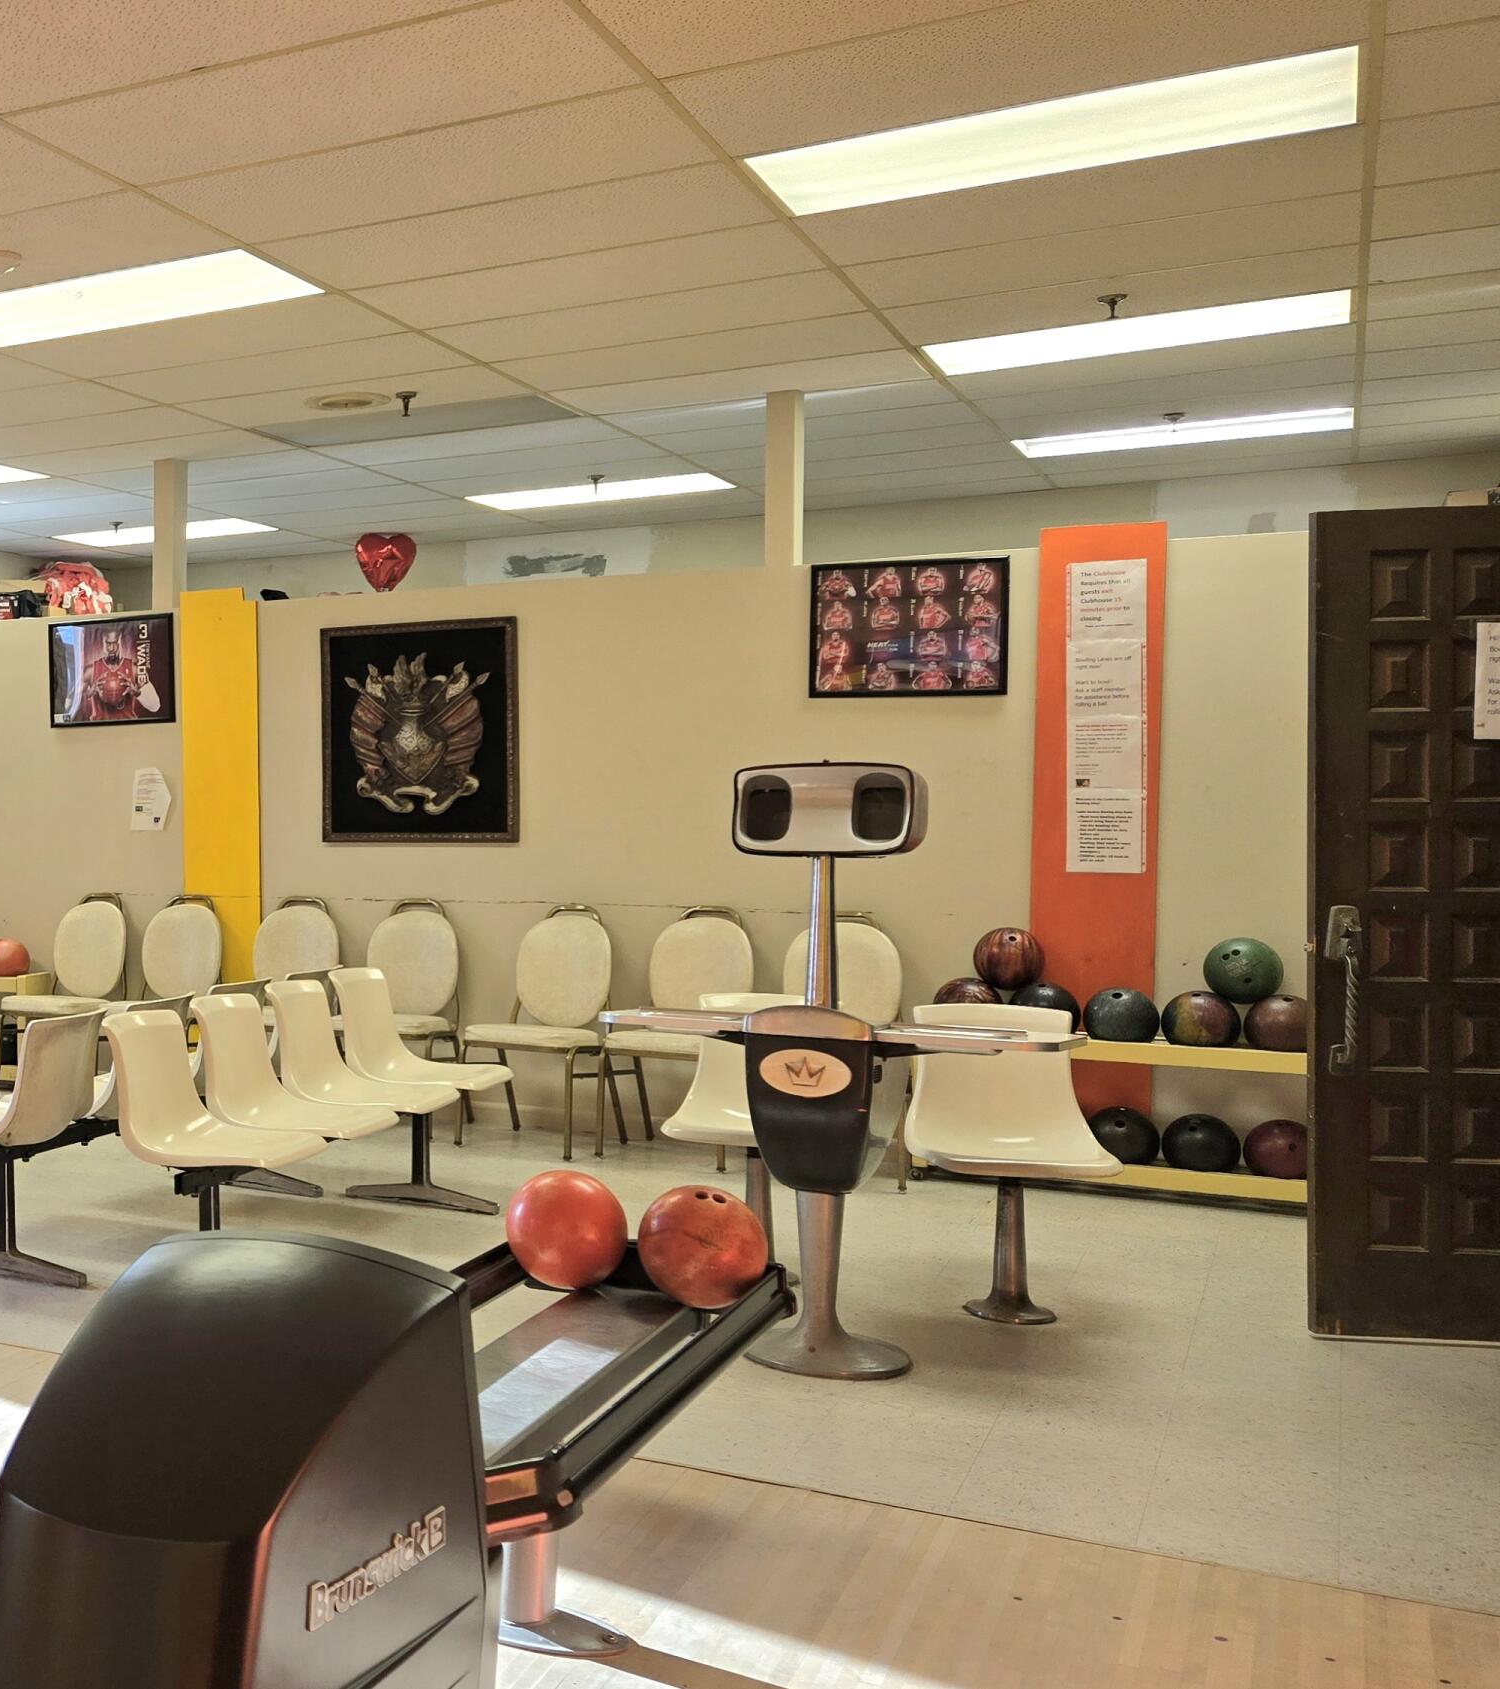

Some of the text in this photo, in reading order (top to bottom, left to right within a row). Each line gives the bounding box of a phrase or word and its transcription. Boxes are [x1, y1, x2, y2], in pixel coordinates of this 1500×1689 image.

[139, 623, 148, 639] 3
[137, 644, 146, 684] WADE
[305, 1520, 429, 1632] Brunswick
